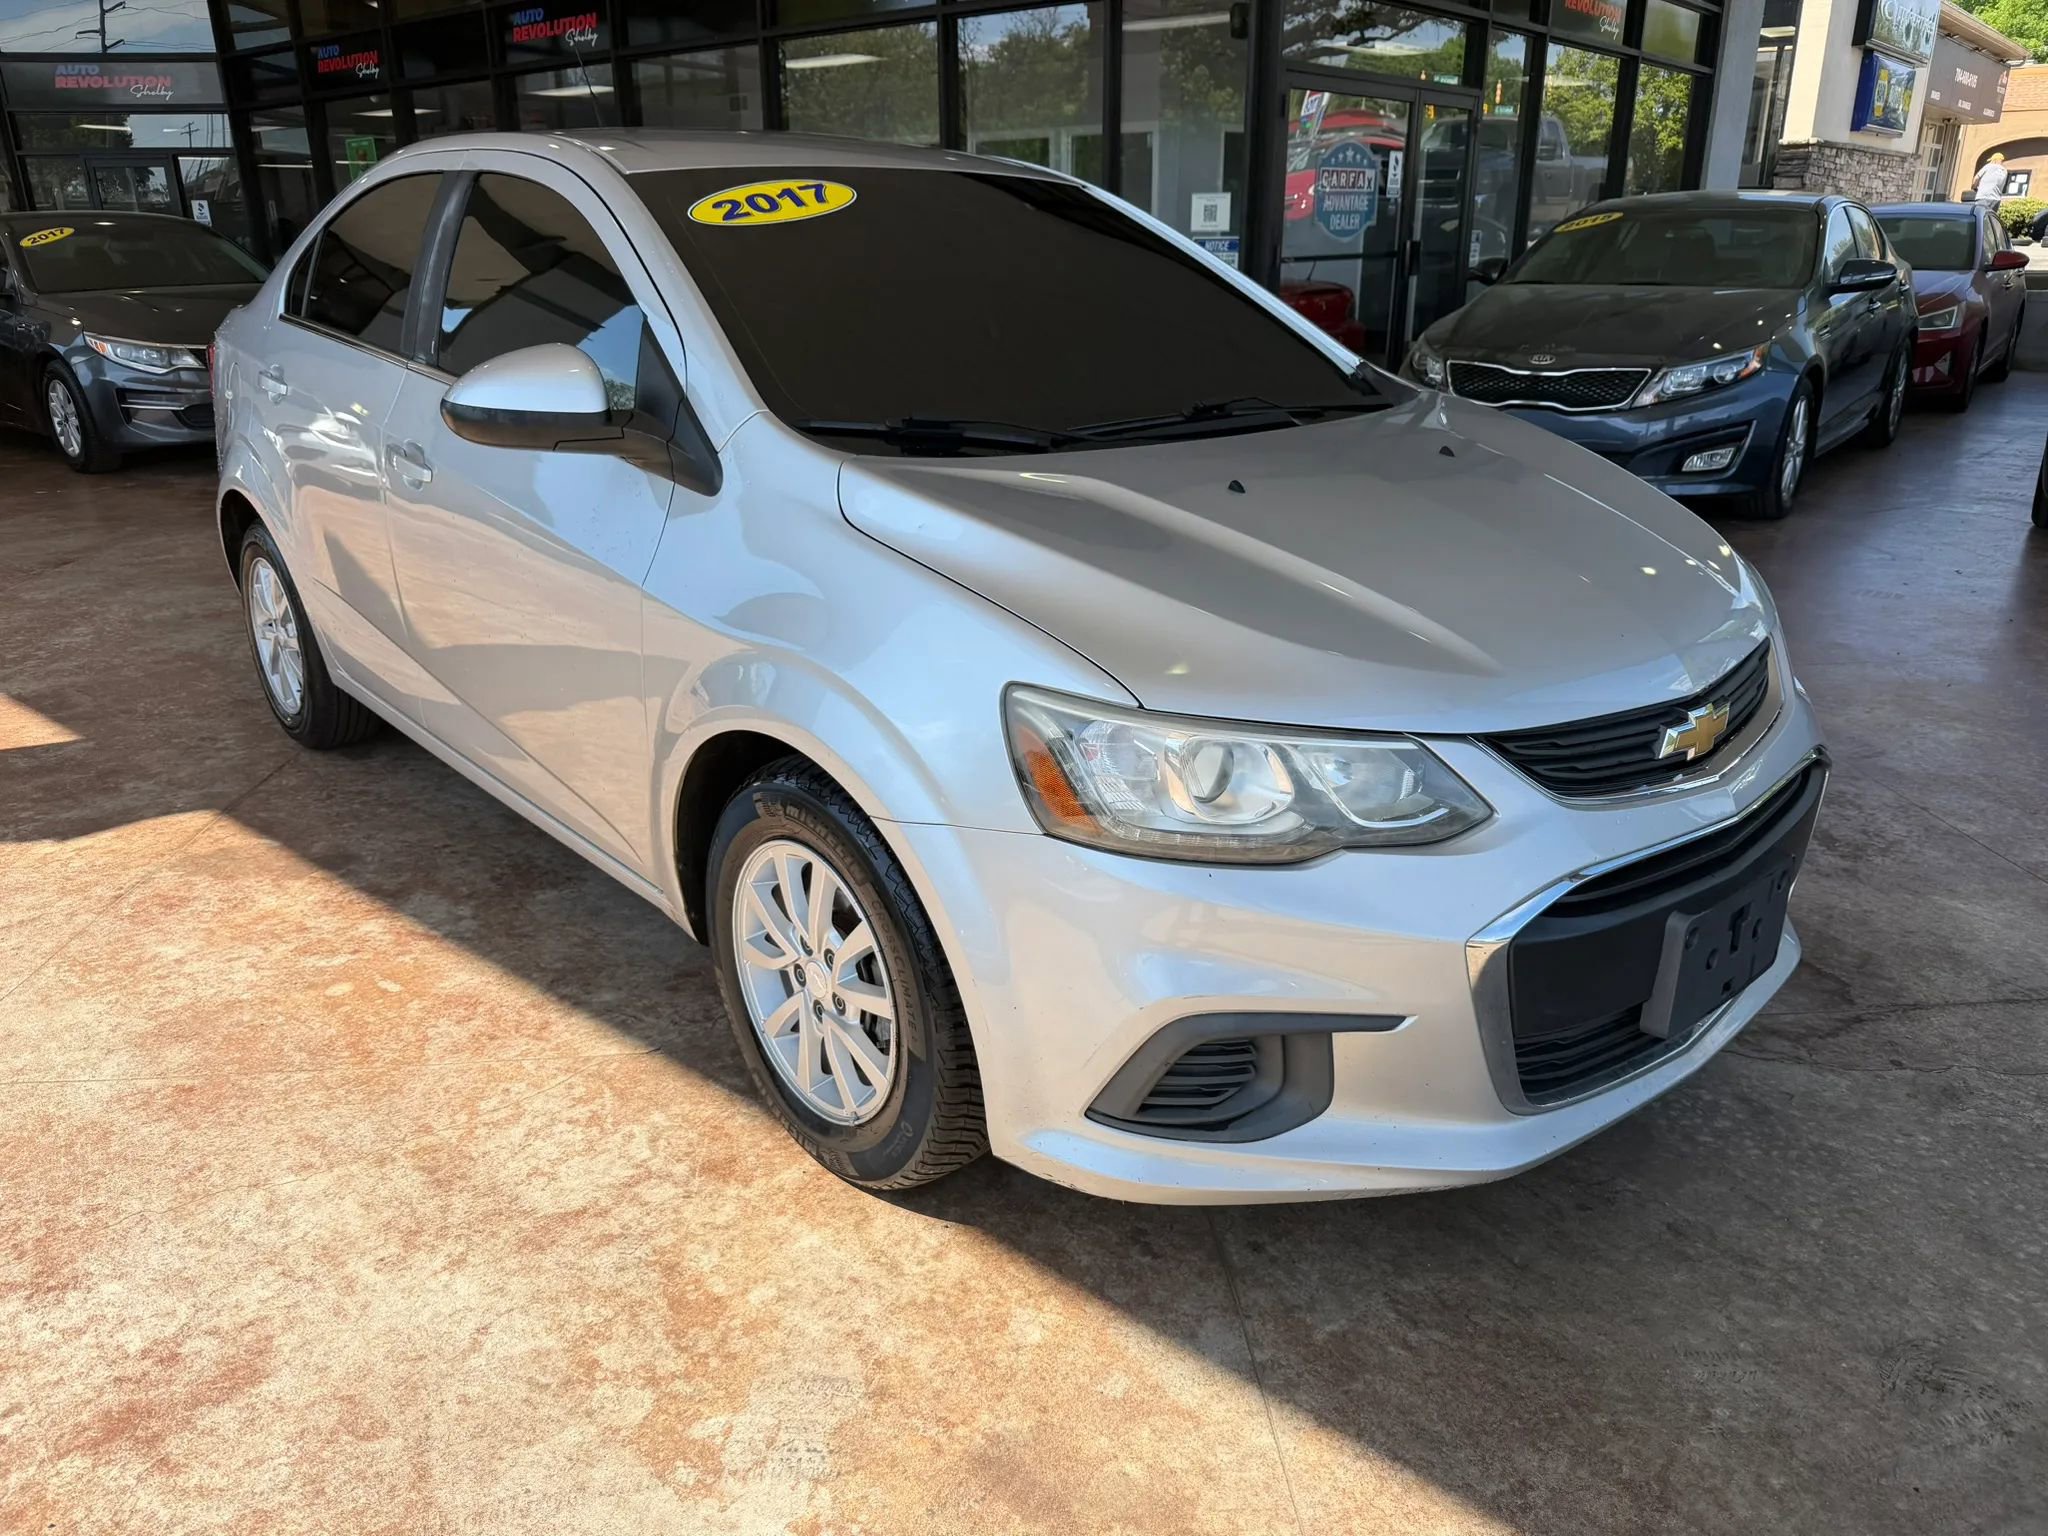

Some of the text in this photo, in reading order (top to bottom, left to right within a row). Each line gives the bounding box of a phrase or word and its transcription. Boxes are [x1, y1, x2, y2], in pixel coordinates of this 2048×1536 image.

[513, 8, 544, 25] AUTO
[513, 13, 597, 42] REVOLUTION
[565, 25, 598, 47] Shelby
[318, 44, 339, 59] AUTO
[56, 64, 99, 75] AUTO
[318, 50, 378, 72] REVOLUTION
[55, 75, 172, 89] REVOLUTION
[130, 83, 174, 101] Shelby
[1322, 170, 1373, 190] CARFAX
[712, 183, 827, 221] 2017
[1323, 194, 1369, 211] ADVANTAGE
[1329, 214, 1360, 230] DEALER
[27, 228, 65, 244] 2017
[1205, 240, 1230, 251] NOTICE
